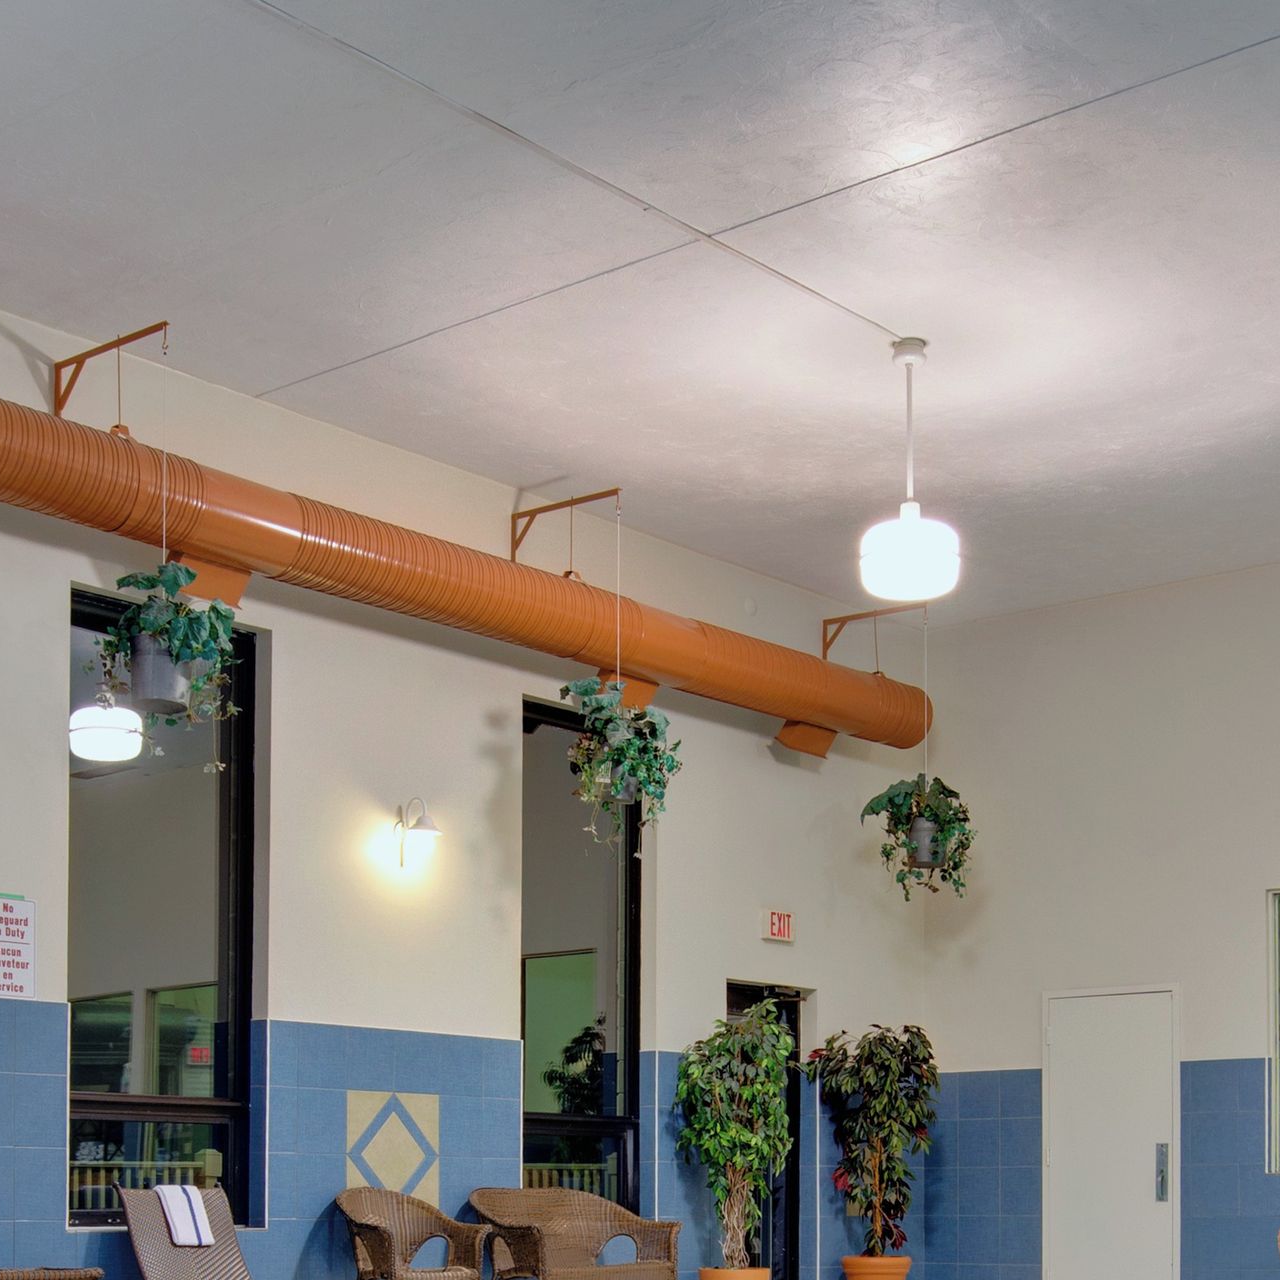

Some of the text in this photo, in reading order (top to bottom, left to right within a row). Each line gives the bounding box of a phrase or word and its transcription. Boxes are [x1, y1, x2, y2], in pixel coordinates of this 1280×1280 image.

[2, 903, 14, 913] No
[770, 911, 791, 939] EXIT
[5, 927, 25, 939] Duty
[2, 971, 13, 980] en
